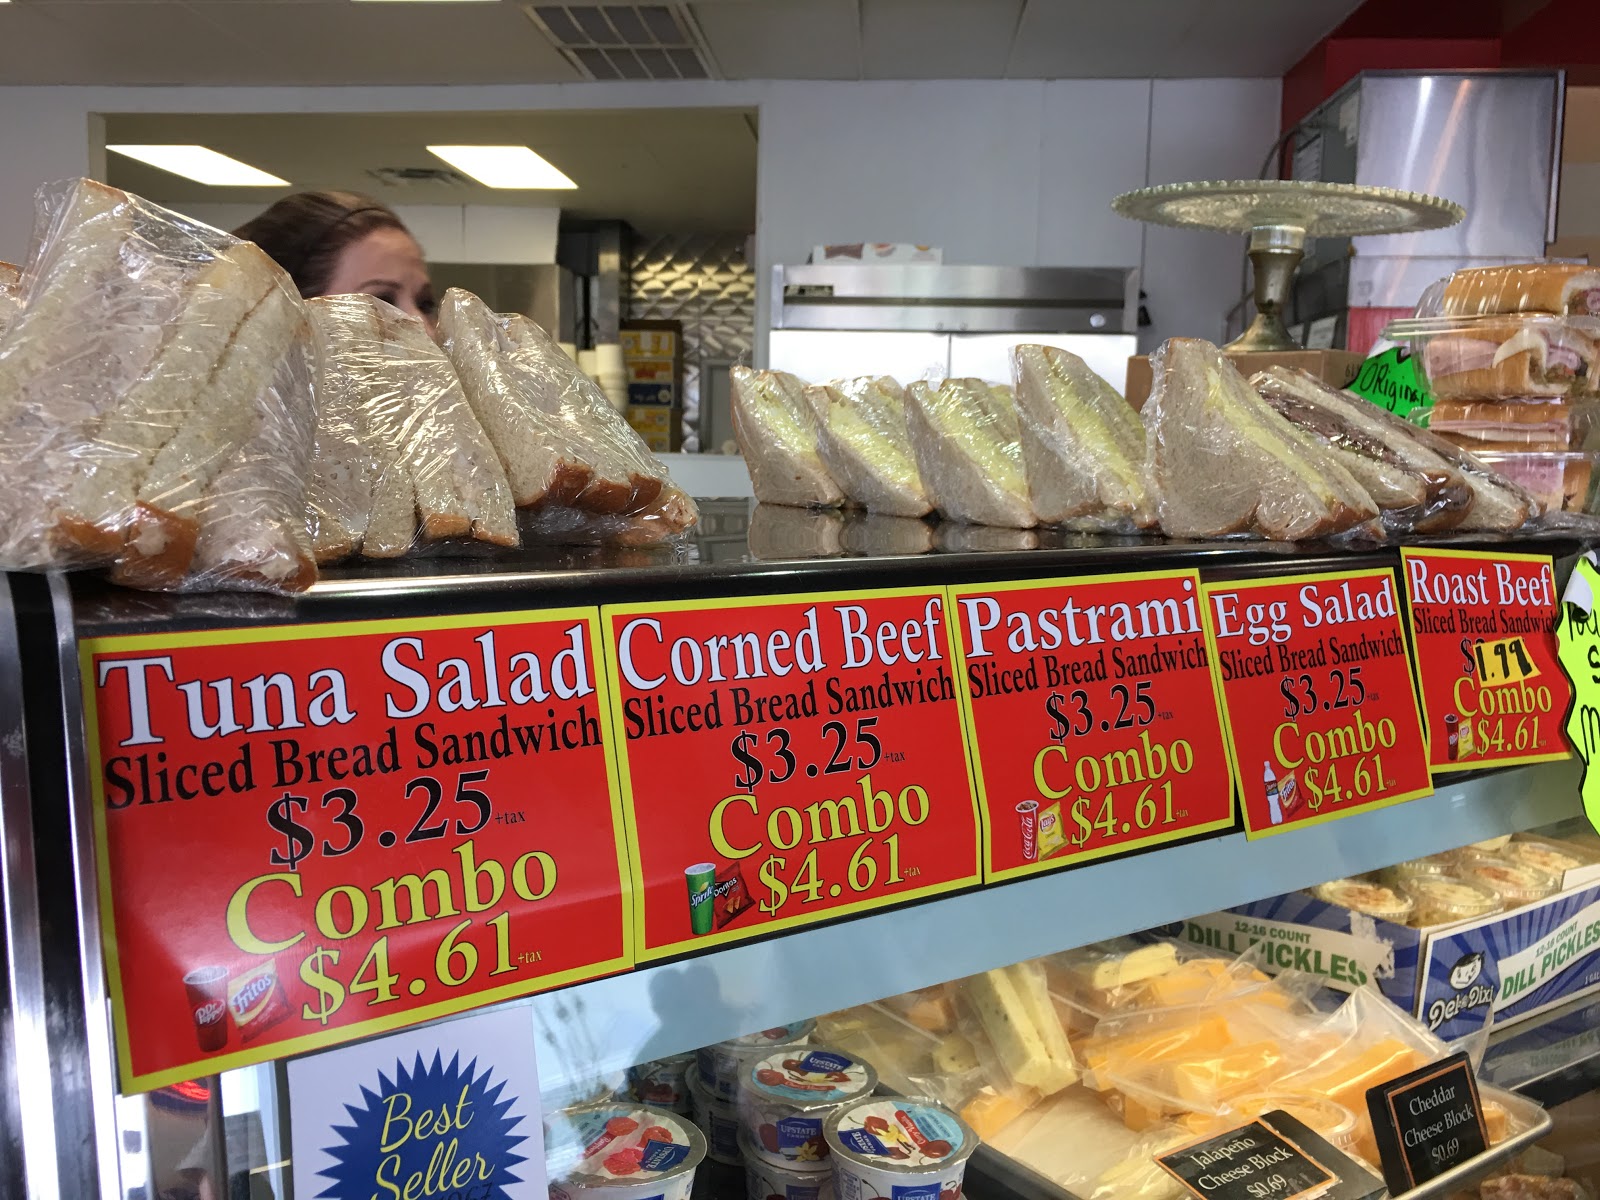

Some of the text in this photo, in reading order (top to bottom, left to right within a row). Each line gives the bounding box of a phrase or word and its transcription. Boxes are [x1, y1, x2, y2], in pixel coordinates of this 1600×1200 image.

[1210, 576, 1397, 646] Egg Salad
[1407, 558, 1552, 607] Roast Beef
[618, 597, 944, 691] Corned Beef
[958, 579, 1204, 659] Pastrami
[1413, 607, 1457, 635] Sliced
[1459, 609, 1497, 634] Bread
[99, 623, 596, 748] Tuna Salad
[968, 637, 1209, 699] Sliced Bread Sandwich
[1220, 628, 1405, 682] Sliced Bread Sandwich
[624, 665, 957, 740] Sliced Bread Sandwich
[1045, 680, 1156, 744] $3.25
[1280, 666, 1366, 722] $3.25
[1453, 676, 1552, 717] Combo
[106, 705, 603, 810] Sliced Bread Sandwich
[731, 716, 906, 793] $3.25 +tax
[1033, 729, 1194, 800] Combo
[1273, 709, 1397, 770] Combo
[1476, 716, 1540, 757] $4.61
[1304, 753, 1387, 812] $4.61
[266, 768, 527, 871] $3.25 +tax
[708, 773, 930, 860] Combo
[1070, 780, 1176, 849] $4.61
[225, 839, 559, 956] Combo
[714, 877, 737, 898] Doritos
[758, 833, 921, 917] $4.61 +tax
[1234, 920, 1312, 944] 12-16 COUNT
[1502, 920, 1600, 1000] DILL PICKLES
[231, 975, 273, 1015] Fritos
[299, 912, 543, 1025] $4.61 +tax
[380, 1084, 475, 1153] Best
[780, 1125, 817, 1135] UPSTATE
[1405, 1104, 1474, 1147] Cheese Block
[1409, 1086, 1455, 1115] Cheddar
[371, 1137, 495, 1200] Seller
[1191, 1138, 1256, 1169] Jalapeño
[1198, 1147, 1293, 1190] Cheese Block
[1431, 1138, 1459, 1165] $0.69
[1246, 1173, 1287, 1198] $0.69
